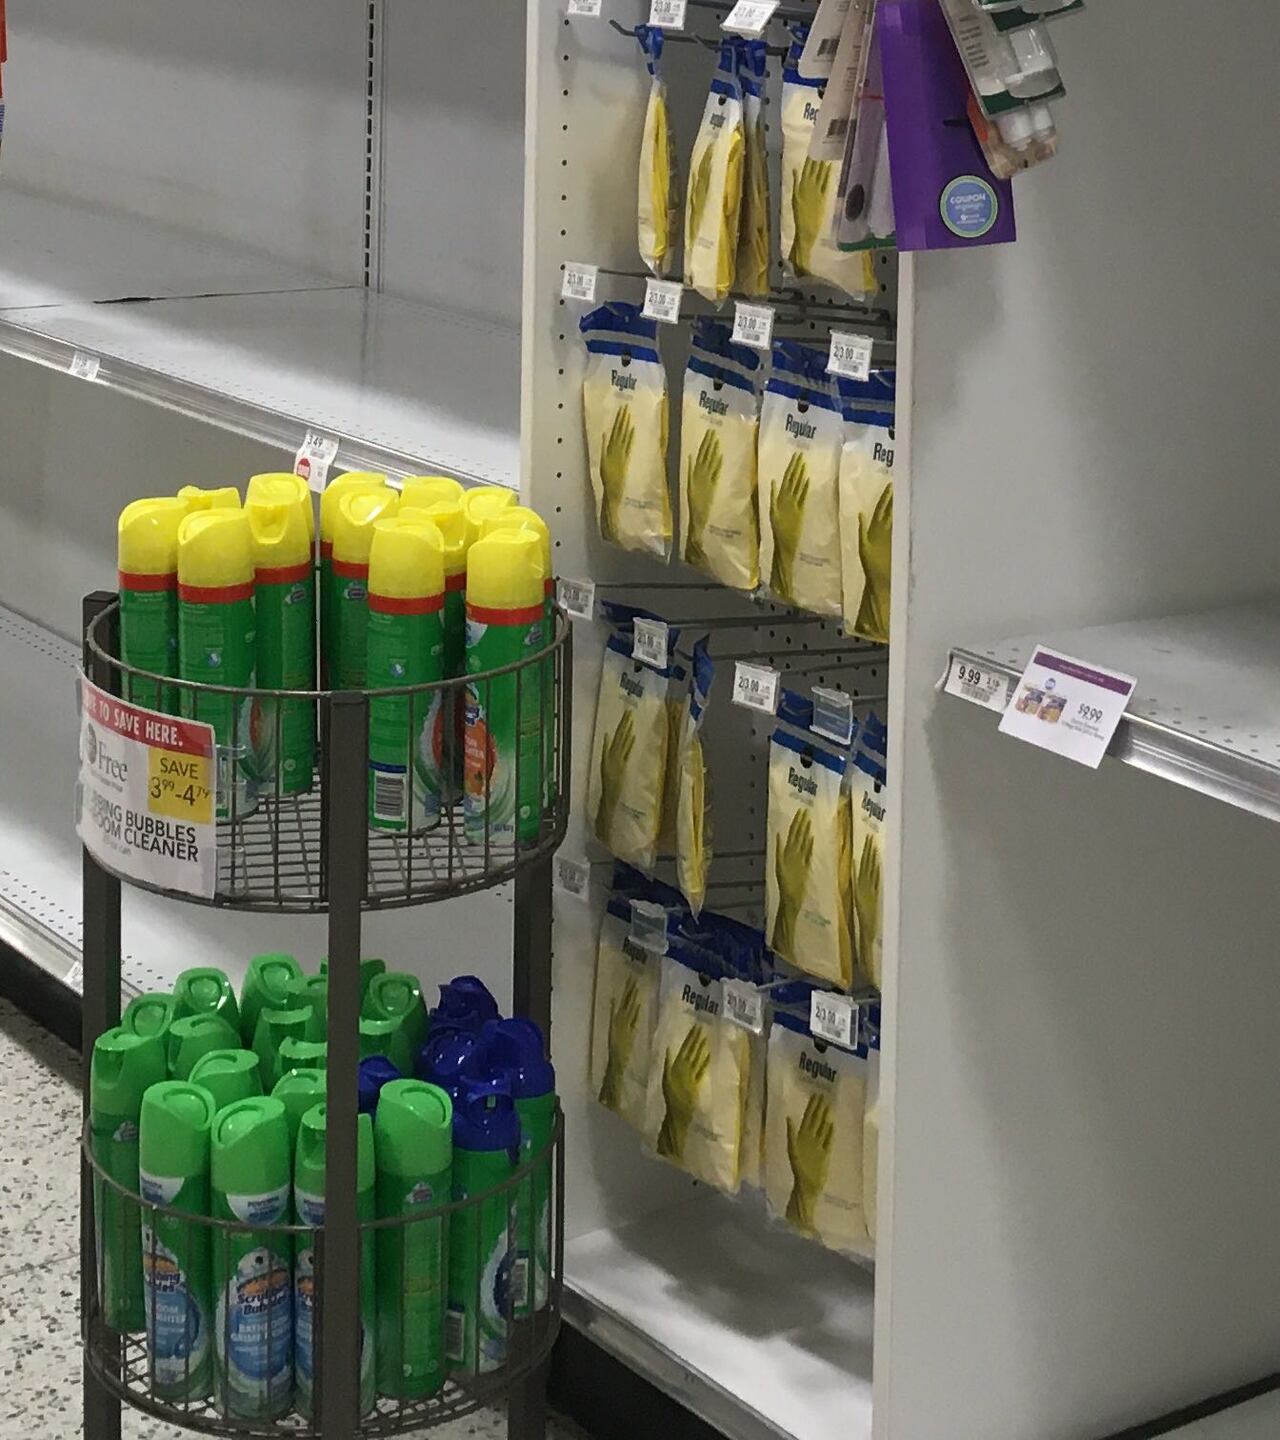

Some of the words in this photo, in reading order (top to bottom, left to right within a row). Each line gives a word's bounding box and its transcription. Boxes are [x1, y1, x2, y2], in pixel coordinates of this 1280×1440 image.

[699, 390, 730, 417] Regular
[785, 414, 818, 440] Regular
[958, 665, 982, 685] 9.99
[99, 700, 110, 722] TO
[114, 708, 140, 736] SAVE
[145, 720, 184, 747] HERE.
[1077, 702, 1103, 723] $9.99
[98, 741, 129, 783] Free
[160, 757, 199, 780] SAVE
[788, 765, 819, 797] Regular
[125, 809, 197, 845] BUBBLES
[124, 827, 199, 863] CLEANER
[683, 984, 720, 1016] Regular
[799, 1051, 837, 1083] Regular
